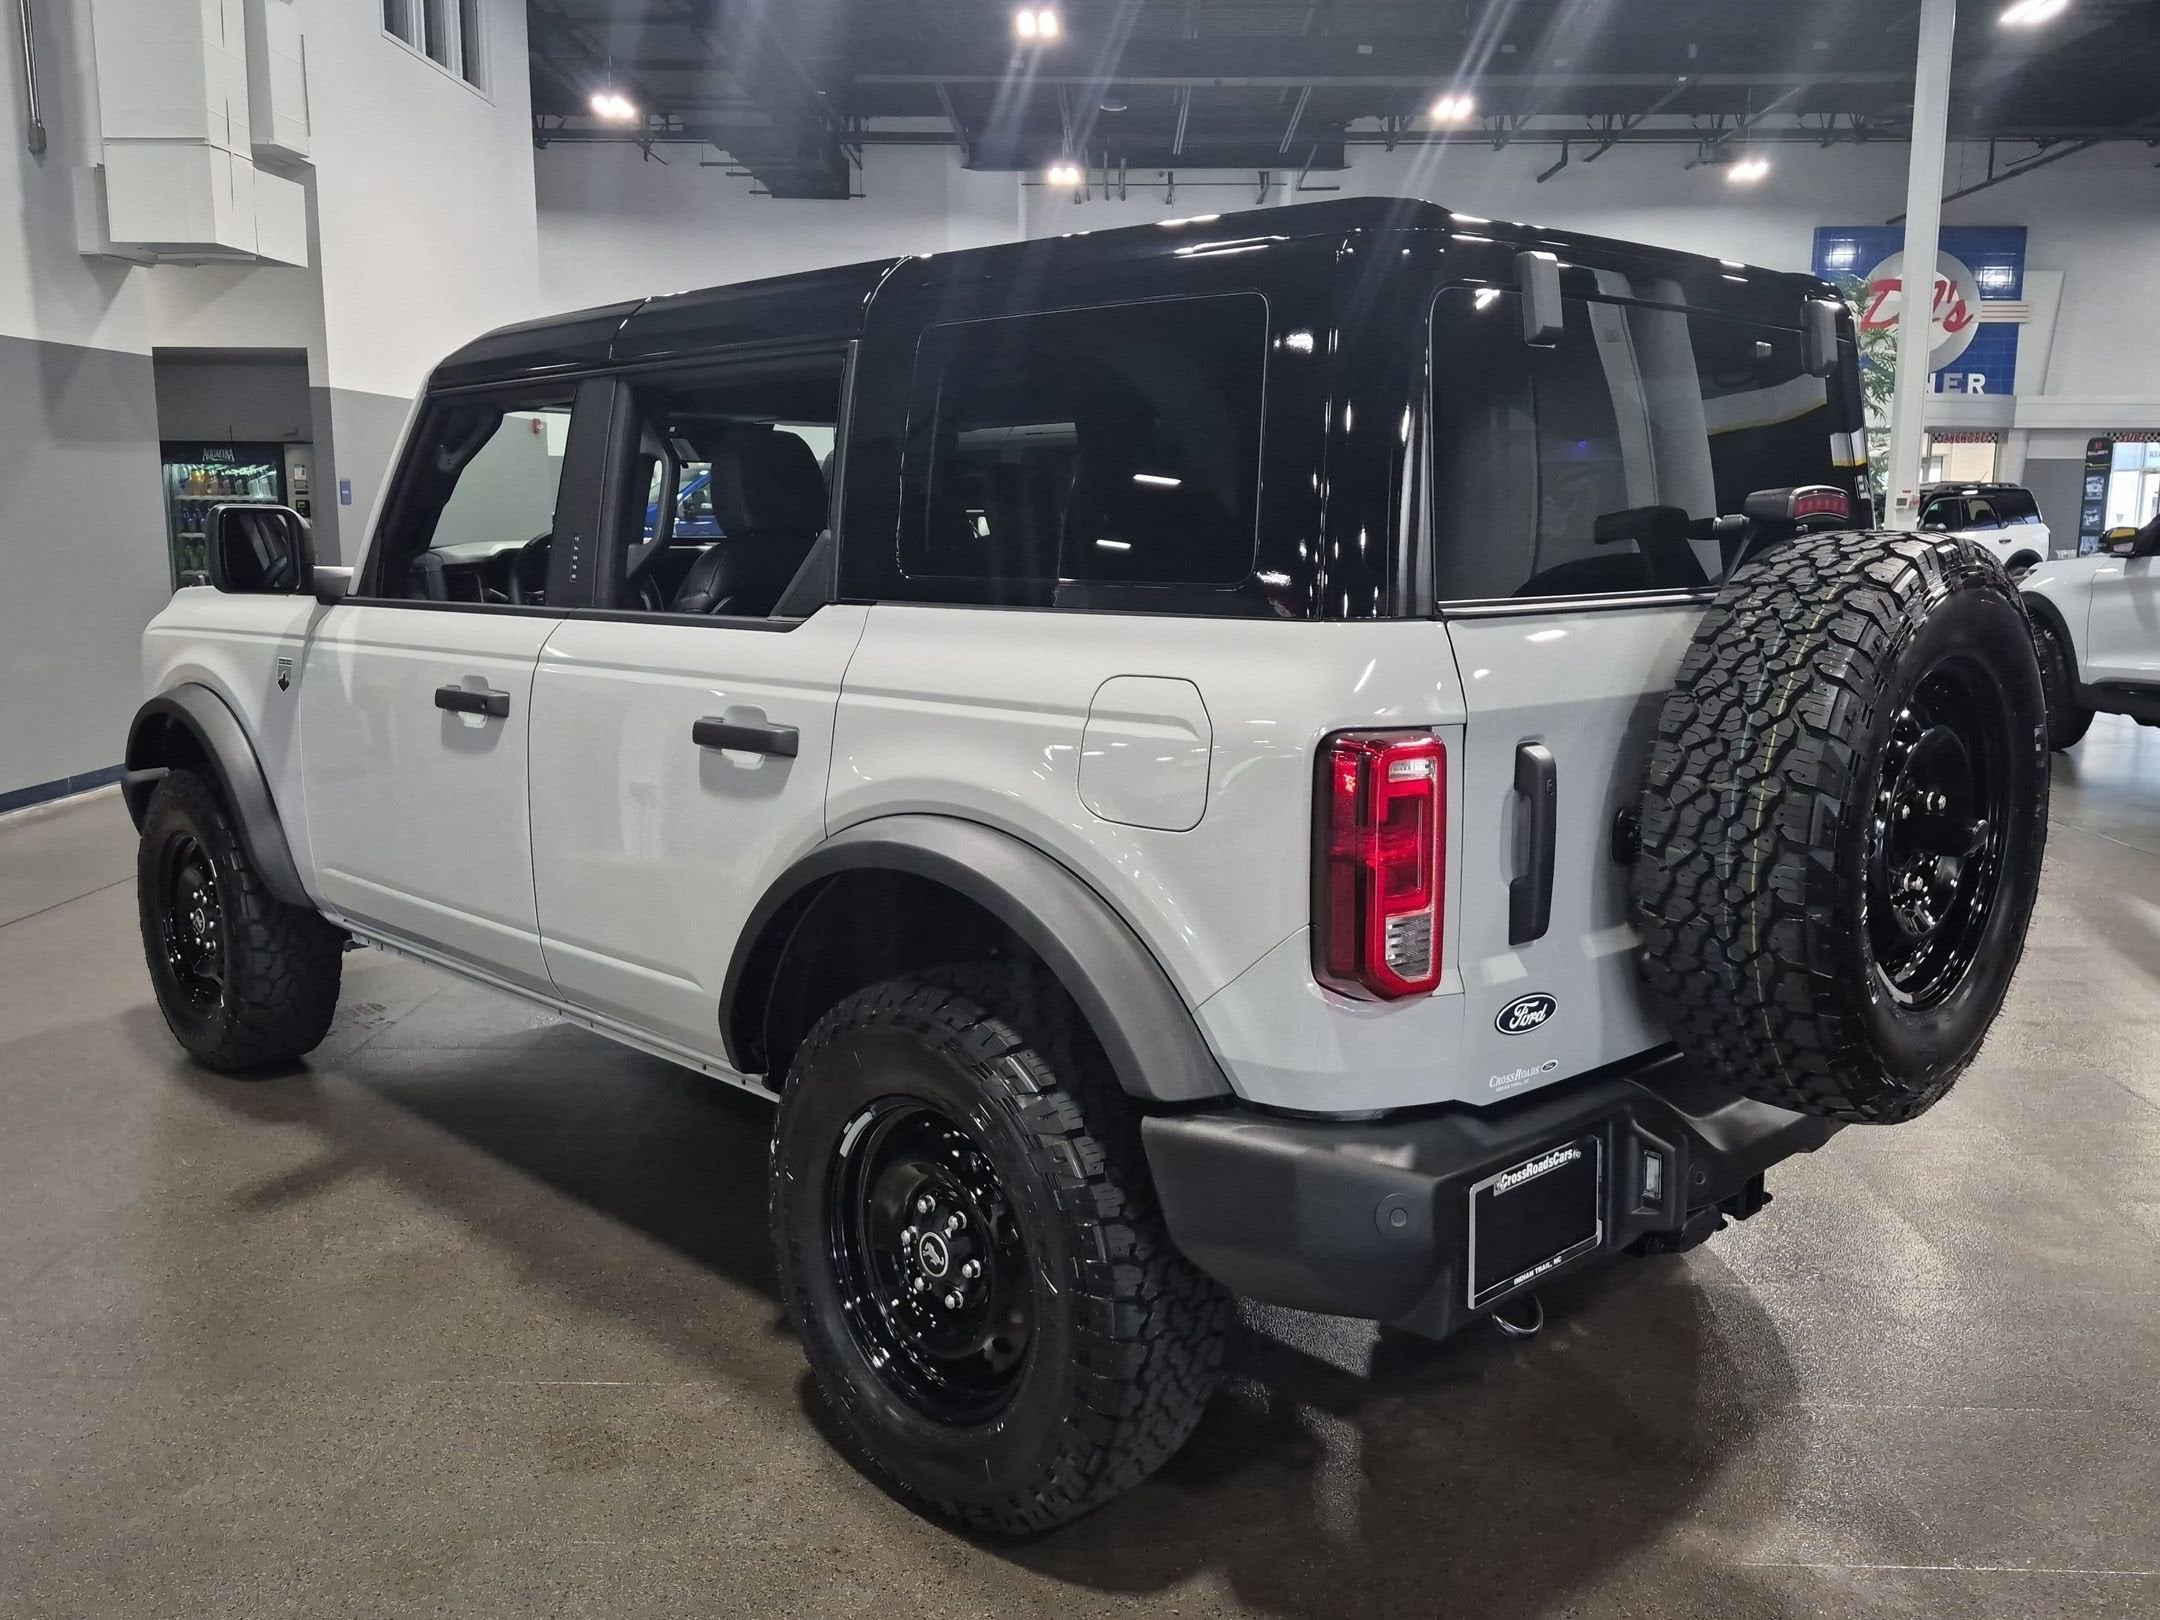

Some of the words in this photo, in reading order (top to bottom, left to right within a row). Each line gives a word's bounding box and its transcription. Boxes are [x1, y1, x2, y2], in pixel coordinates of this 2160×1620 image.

[1509, 1000, 1548, 1029] Ford
[1513, 1269, 1534, 1285] INDIAN
[1553, 1255, 1562, 1265] NC
